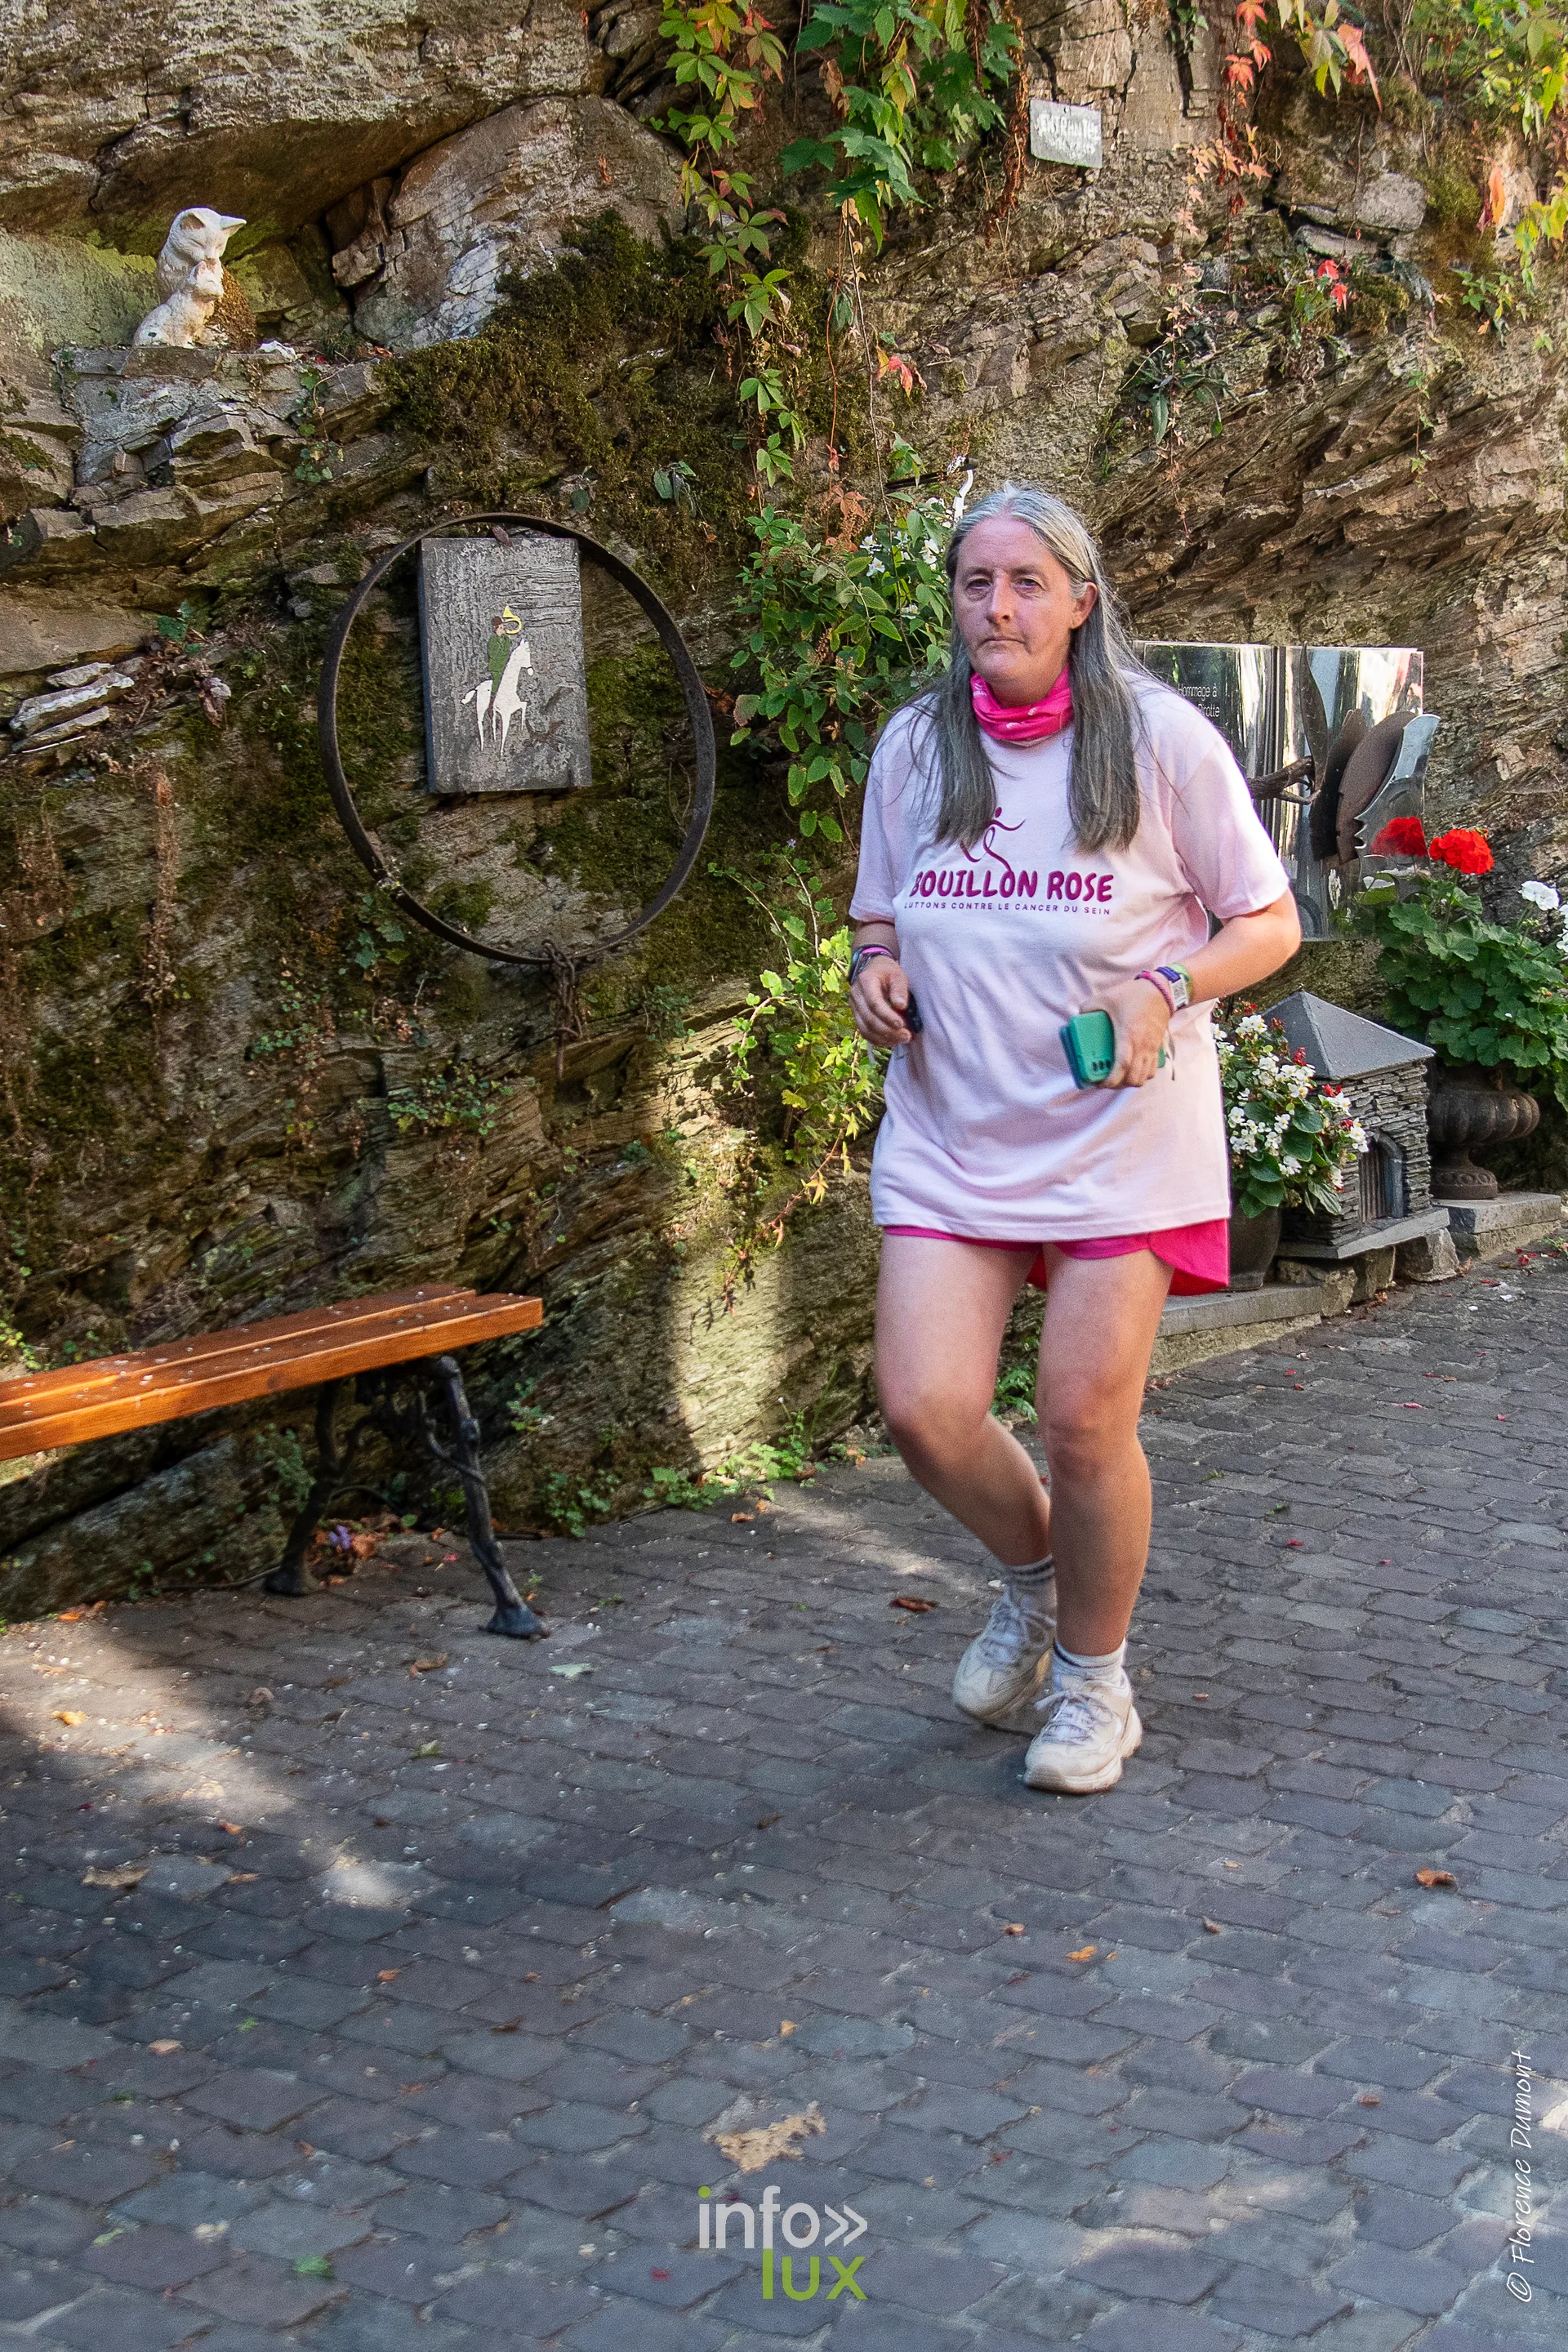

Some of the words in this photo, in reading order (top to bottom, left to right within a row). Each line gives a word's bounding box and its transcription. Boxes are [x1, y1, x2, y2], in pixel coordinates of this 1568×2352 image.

[1177, 683, 1210, 702] Hommage
[1212, 683, 1218, 697] à
[909, 870, 1038, 898] BOUILLON
[1046, 870, 1114, 902] ROSE
[951, 902, 992, 911] CONTRE
[1014, 903, 1058, 911] CANCER
[1084, 906, 1110, 915] SEIN
